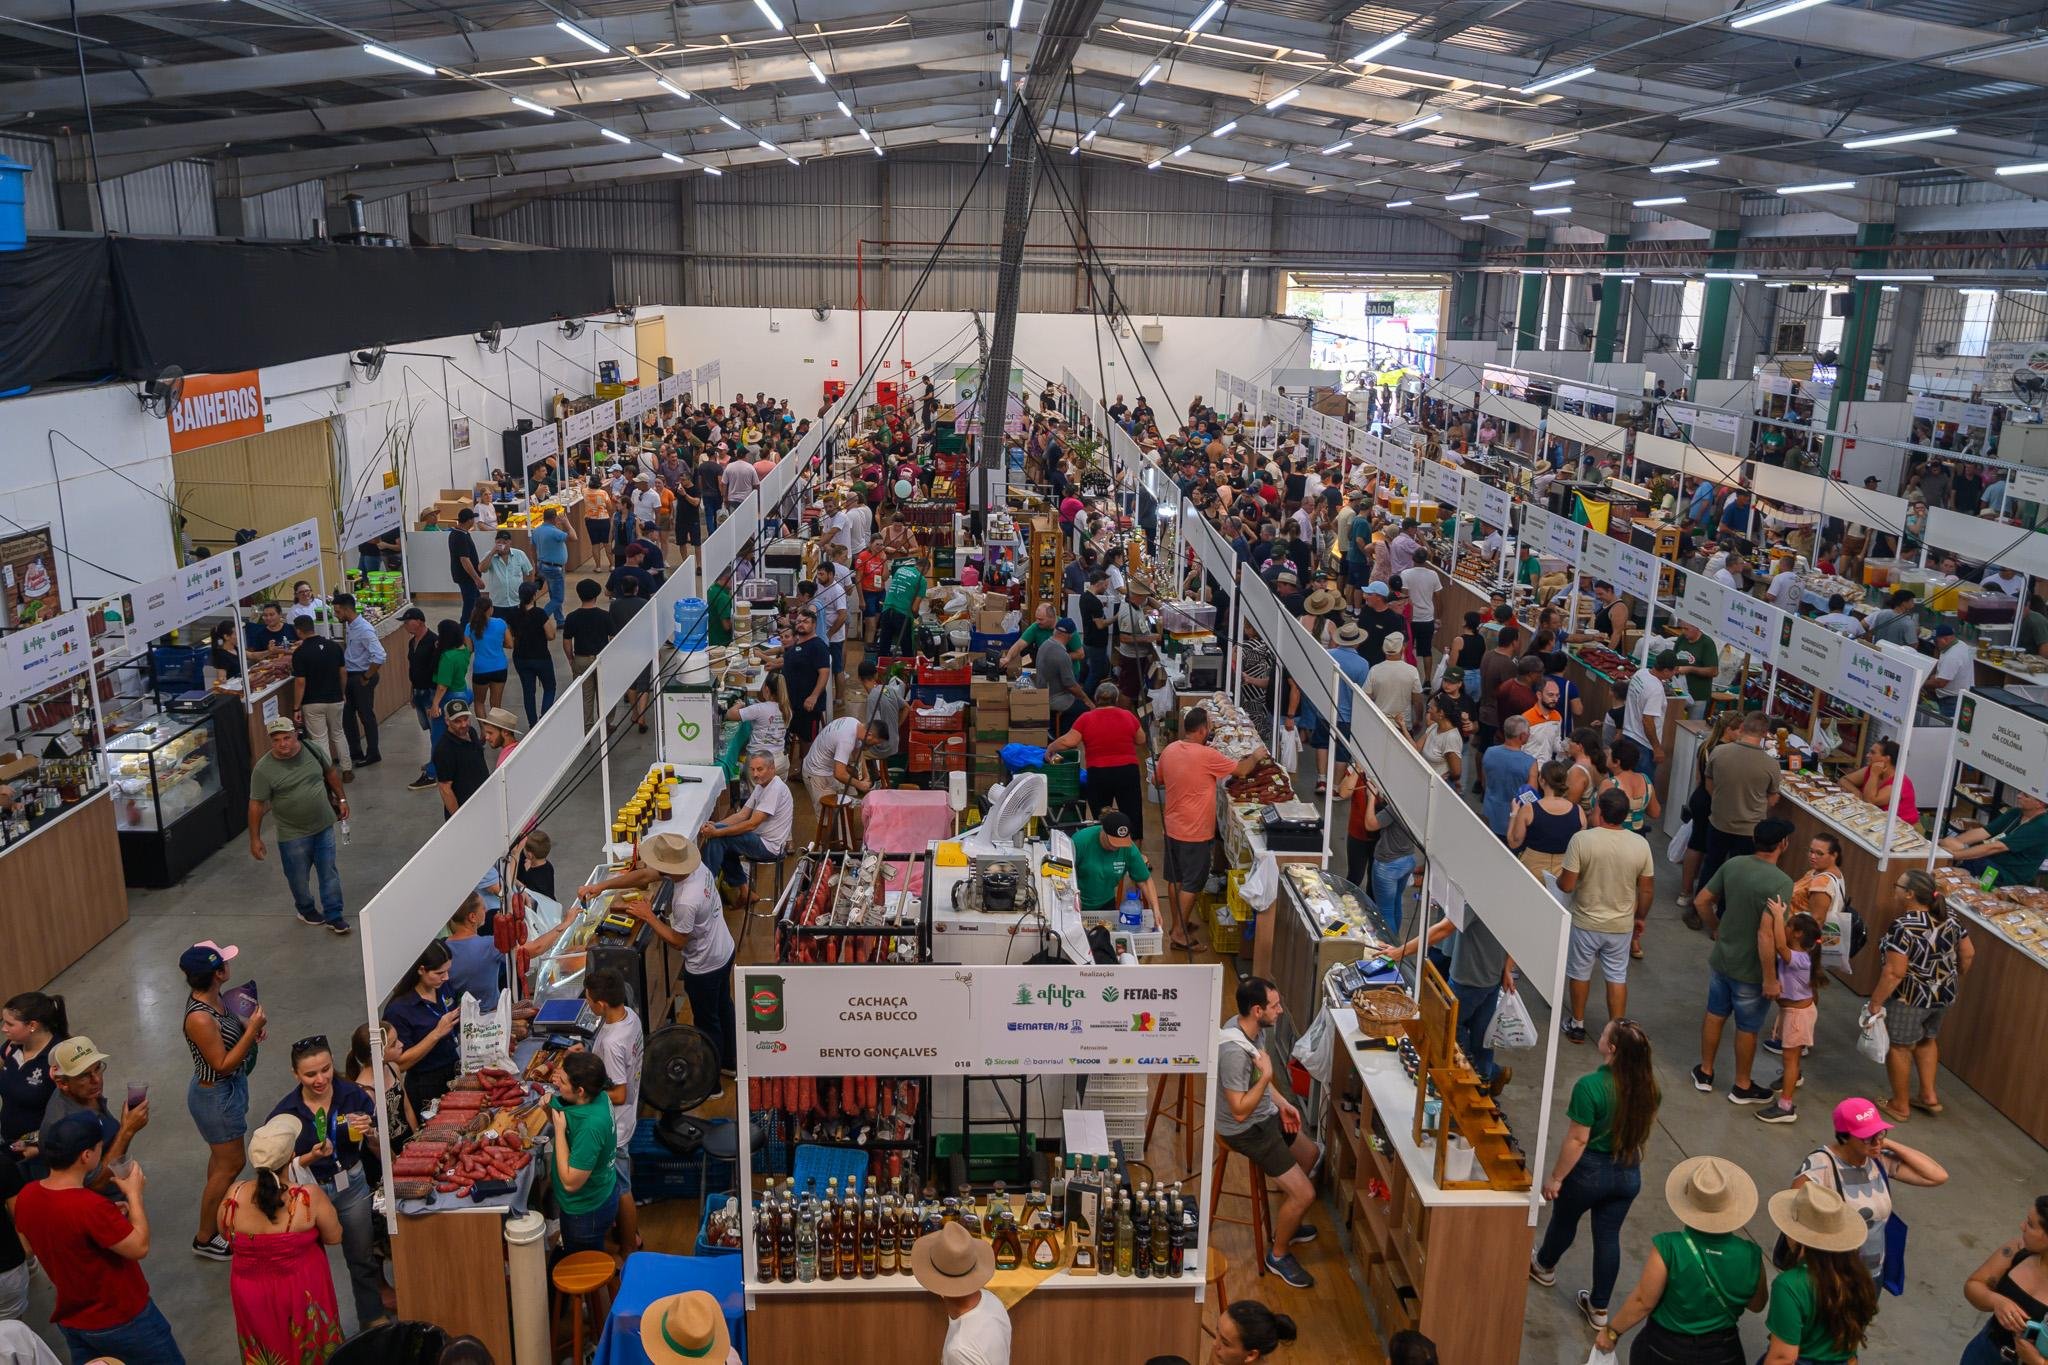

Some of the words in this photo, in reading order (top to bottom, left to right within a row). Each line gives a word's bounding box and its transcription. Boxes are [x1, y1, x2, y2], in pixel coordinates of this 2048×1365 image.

[1366, 302, 1393, 315] SAÍDA
[172, 385, 259, 433] BANHEIROS
[1997, 726, 2021, 741] DELÍCIAS
[2004, 760, 2027, 776] GRANDE
[1123, 988, 1178, 1000] FETAG-RS
[848, 996, 908, 1009] CACHAÇA
[839, 1011, 871, 1021] CASA
[875, 1011, 918, 1021] BUCCO
[1017, 1019, 1069, 1031] EMATER/RS
[819, 1048, 861, 1058] BENTO
[863, 1047, 938, 1060] GONÇALVES
[993, 1057, 1019, 1065] Sicredi
[1032, 1057, 1064, 1065] banrisul
[1076, 1057, 1101, 1065] SICOOB
[1138, 1057, 1168, 1065] CAIXA
